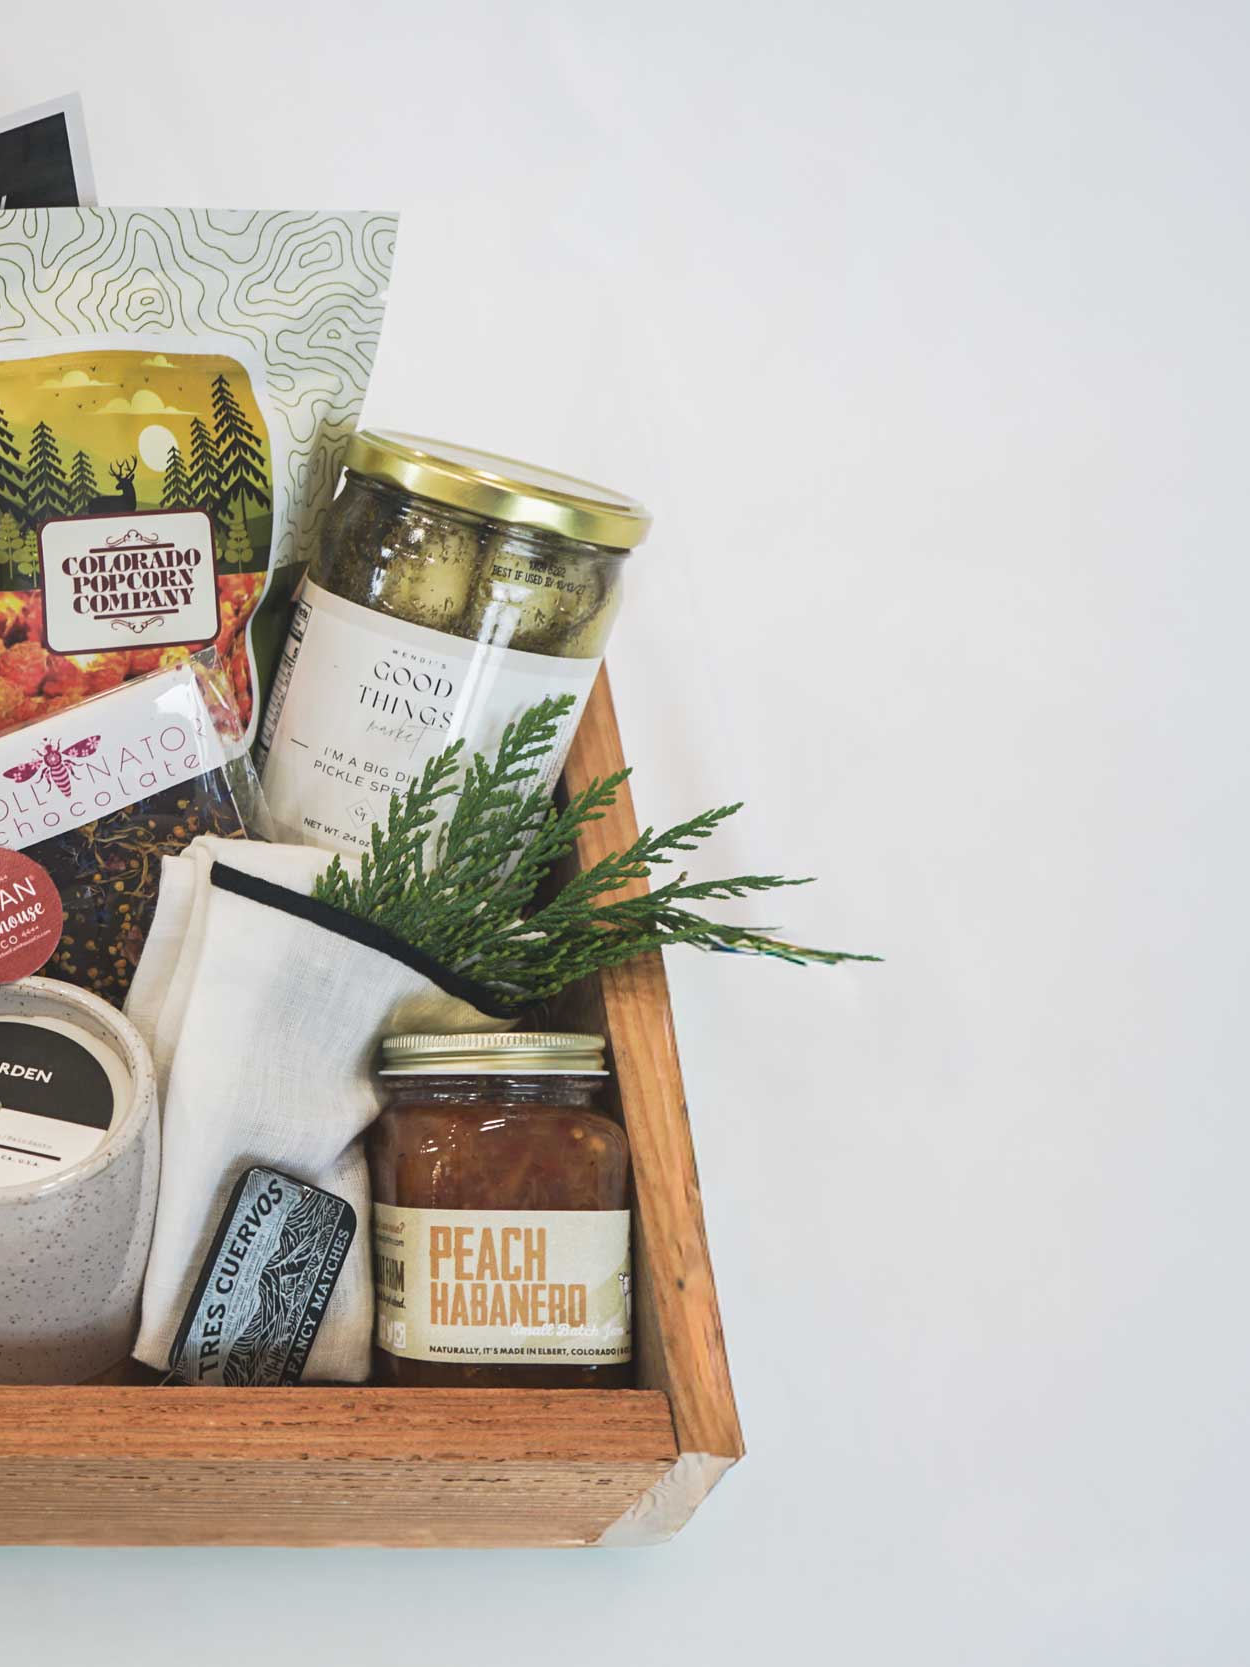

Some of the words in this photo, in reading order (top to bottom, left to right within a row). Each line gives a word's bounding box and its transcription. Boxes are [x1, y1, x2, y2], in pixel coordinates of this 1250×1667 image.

[62, 548, 201, 576] COLORADO
[492, 565, 512, 578] BEST
[514, 570, 524, 580] IF
[525, 572, 543, 585] USED
[73, 568, 194, 594] POPCORN
[73, 588, 194, 614] COMPANY
[392, 649, 447, 670] WENDI'S
[374, 660, 453, 698] GOOD
[359, 684, 454, 730] THINGS
[324, 747, 344, 761] I'M
[348, 757, 358, 767] A
[363, 761, 389, 778] BIG
[313, 759, 365, 787] PICKLE
[369, 780, 411, 800] SPEA
[303, 817, 322, 830] NET
[342, 832, 356, 843] 24
[358, 839, 370, 847] oz
[0, 935, 18, 949] CO
[429, 1226, 546, 1281] PEACH
[199, 1303, 226, 1380] TRES
[216, 1179, 283, 1294] CUERVOS
[287, 1315, 317, 1374] FANCY
[312, 1229, 350, 1311] MATCHES
[430, 1283, 587, 1328] HABANERO
[429, 1345, 481, 1357] NATURALLY,
[483, 1347, 498, 1355] IT'S
[500, 1347, 525, 1355] MADE
[526, 1347, 537, 1355] IN
[538, 1347, 569, 1356] ELBERT,
